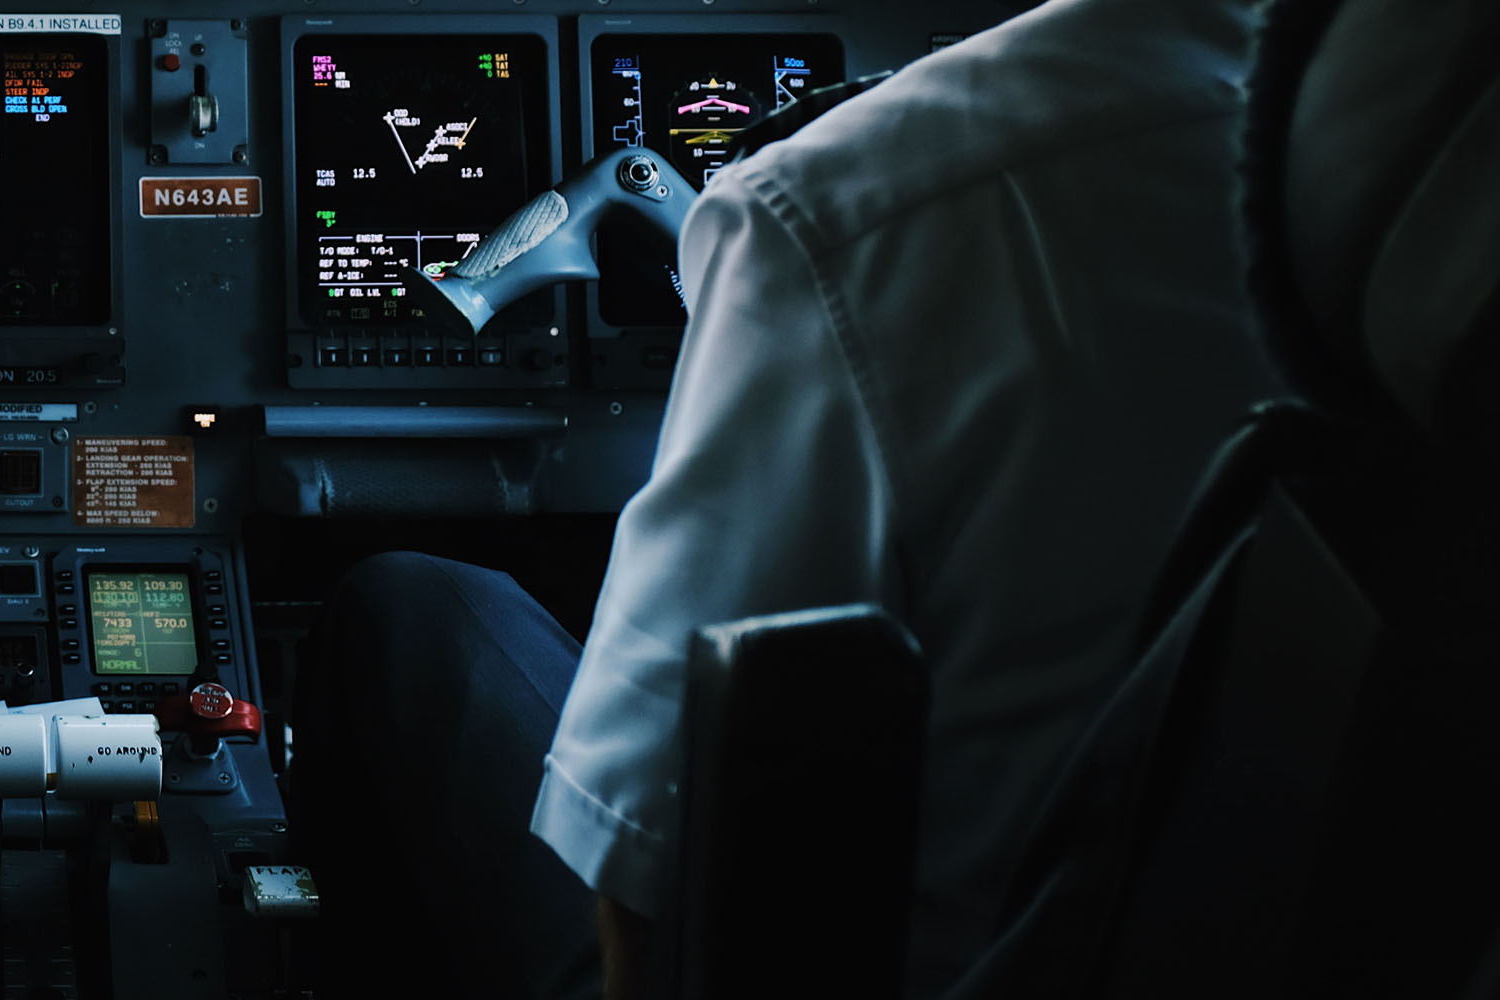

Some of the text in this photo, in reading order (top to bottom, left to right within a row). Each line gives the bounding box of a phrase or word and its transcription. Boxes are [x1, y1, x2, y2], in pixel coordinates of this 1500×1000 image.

[8, 18, 44, 30] B9.4.1
[48, 18, 121, 30] INSTALLED
[312, 55, 332, 65] FMS2
[494, 53, 509, 62] SAT
[495, 61, 509, 71] TAT
[614, 58, 805, 68] 210 5000
[4, 70, 76, 79] AIL SYS INOP
[312, 71, 333, 80] 25.6
[487, 70, 510, 79] 0 TAS
[26, 78, 45, 88] FAIL
[4, 87, 50, 96] STEER INOP
[4, 95, 63, 105] CHECK PERF
[4, 104, 29, 114] CROSS
[48, 104, 68, 114] OPEN
[316, 169, 335, 178] TCAS
[352, 167, 484, 179] 12.5 12.5
[316, 178, 336, 187] AUTO
[154, 187, 249, 206] N643AE
[319, 246, 335, 256] T/O
[336, 246, 360, 256] MODE:
[319, 259, 372, 268] REF TO TEMP:
[319, 271, 334, 281] REF
[350, 288, 381, 297] OIL LVL
[26, 369, 57, 383] 20.5
[3, 433, 37, 441] LG WRN
[154, 462, 173, 470] KIAS
[5, 499, 34, 507] CUTOUT
[95, 580, 183, 591] 135.92 109.30
[145, 592, 185, 602] 112.80
[103, 618, 188, 628] 7433 570.0
[133, 648, 142, 658] 6
[102, 660, 142, 670] NORMAL
[97, 746, 158, 756] GO AROUND
